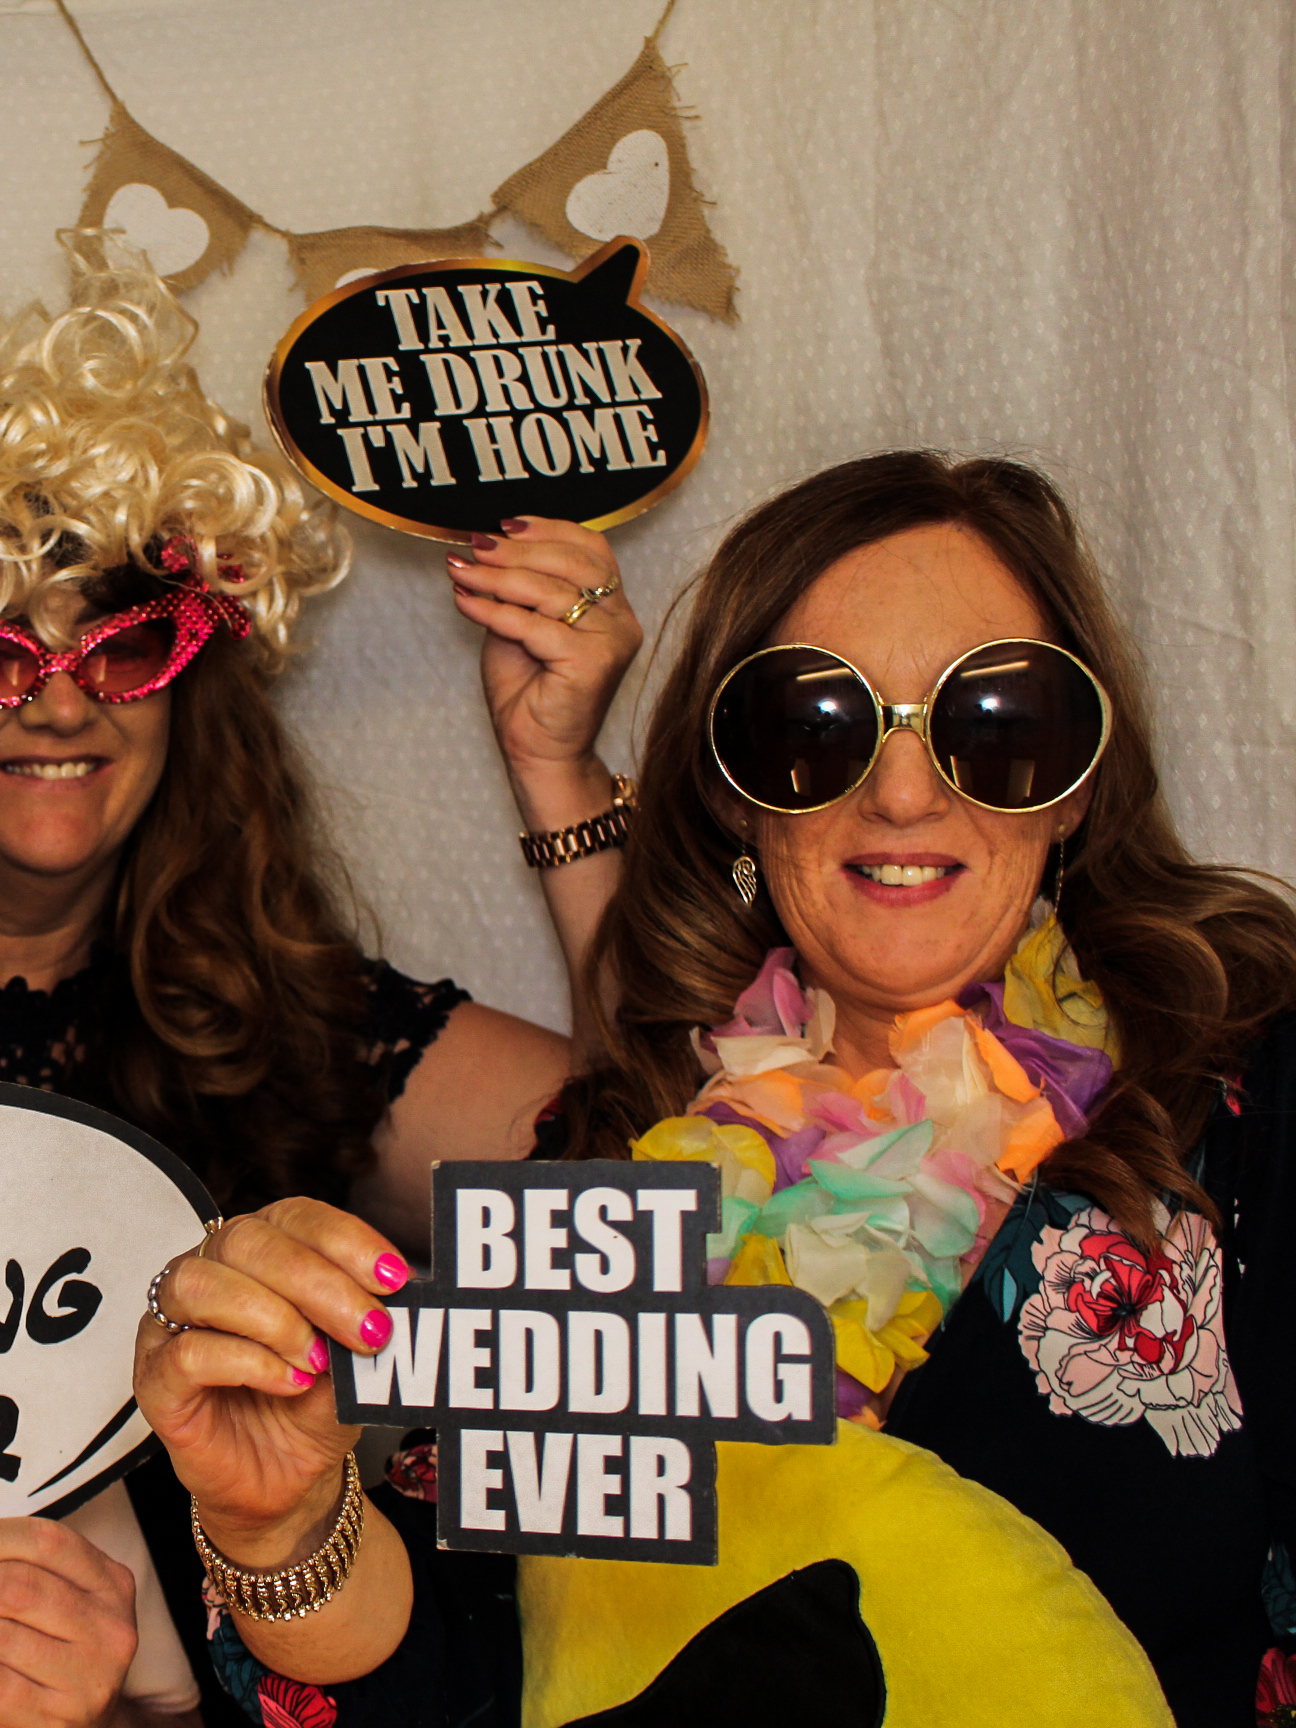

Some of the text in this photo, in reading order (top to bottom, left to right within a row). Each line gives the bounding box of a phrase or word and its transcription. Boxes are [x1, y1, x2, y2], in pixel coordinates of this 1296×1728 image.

[376, 280, 556, 350] TAKE
[304, 339, 662, 424] ME DRUNK
[337, 405, 666, 492] I'M HOME
[456, 1187, 697, 1293] BEST
[351, 1306, 813, 1422] WEDDING
[459, 1428, 693, 1541] EVER
